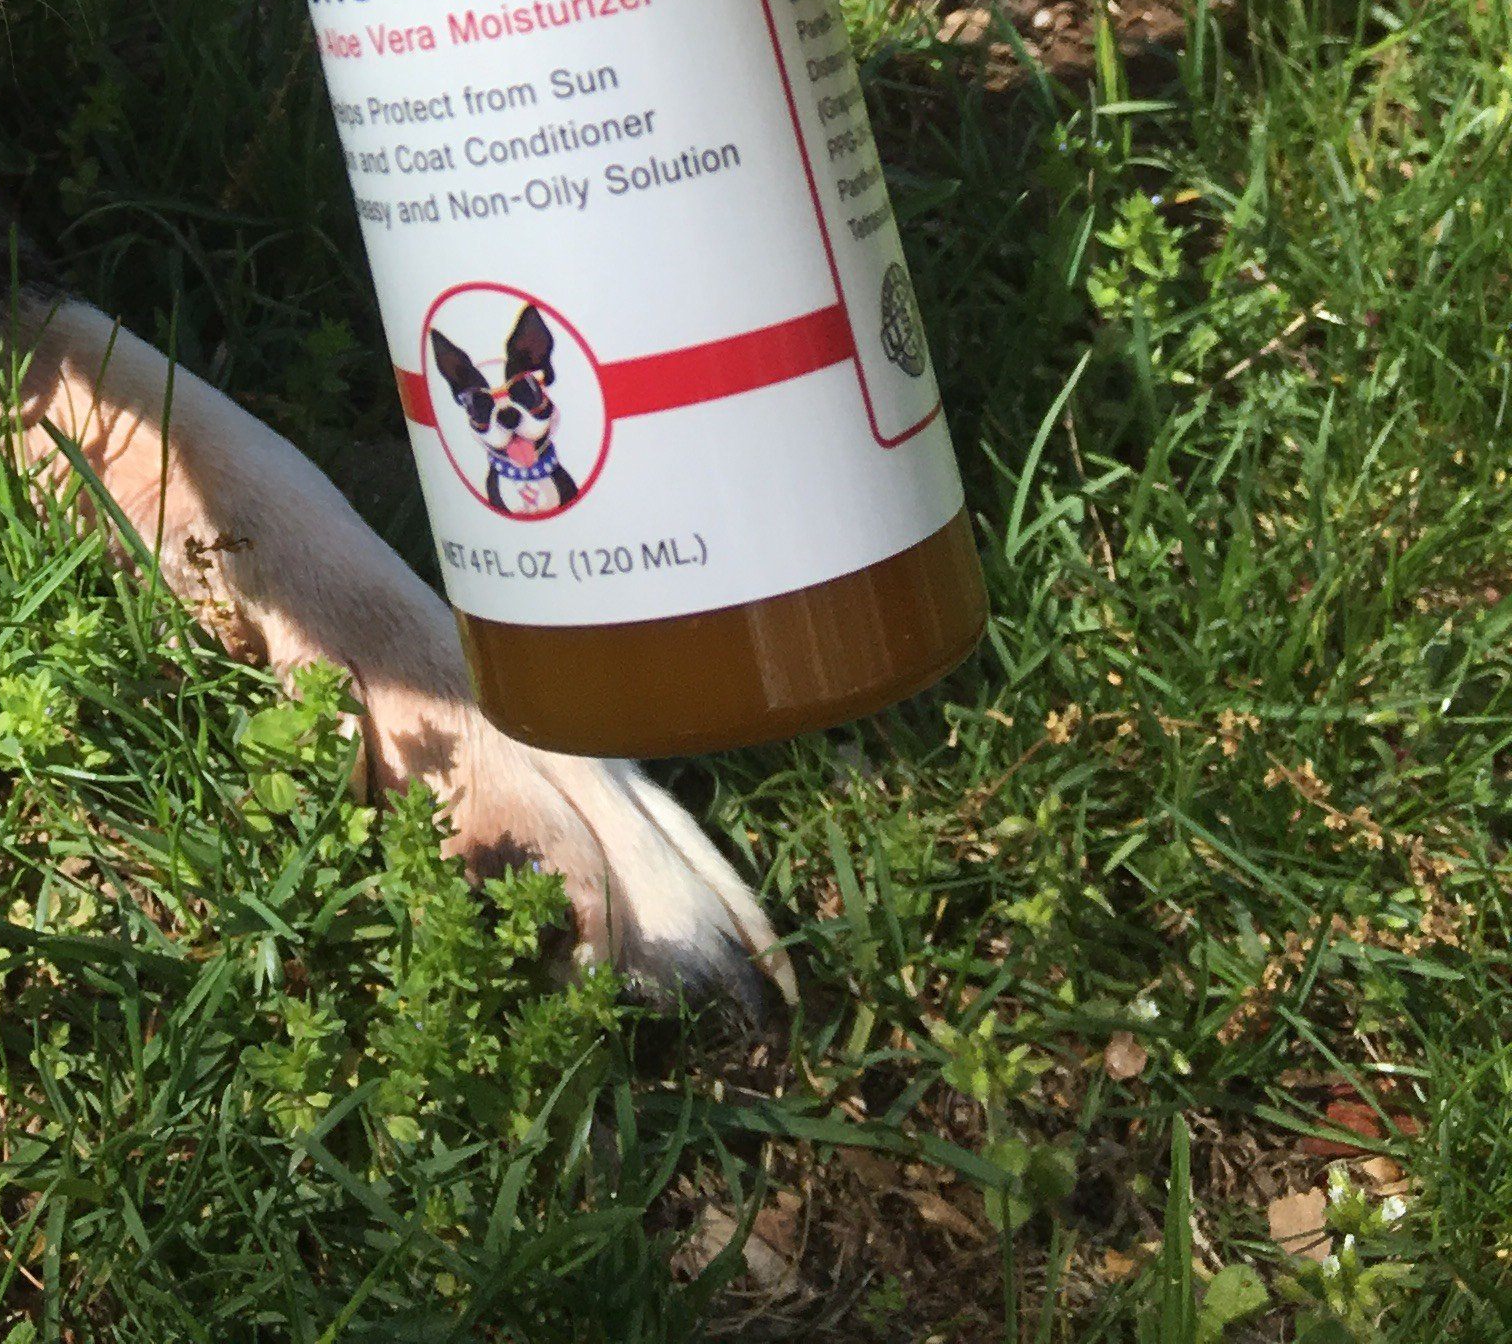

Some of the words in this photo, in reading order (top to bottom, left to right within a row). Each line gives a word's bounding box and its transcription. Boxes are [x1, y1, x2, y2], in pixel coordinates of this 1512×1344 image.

[365, 23, 438, 57] Vera
[366, 91, 458, 125] Protect
[464, 80, 539, 115] from
[549, 64, 620, 101] Sun
[359, 146, 391, 175] and
[393, 142, 458, 175] Coat
[463, 108, 659, 168] Conditioner
[398, 193, 442, 224] and
[447, 173, 591, 221] Non-Oily
[604, 141, 743, 196] Solution
[471, 550, 482, 575] 4
[517, 550, 559, 580] OZ
[568, 546, 634, 583] (120
[640, 532, 709, 570] ML.)
